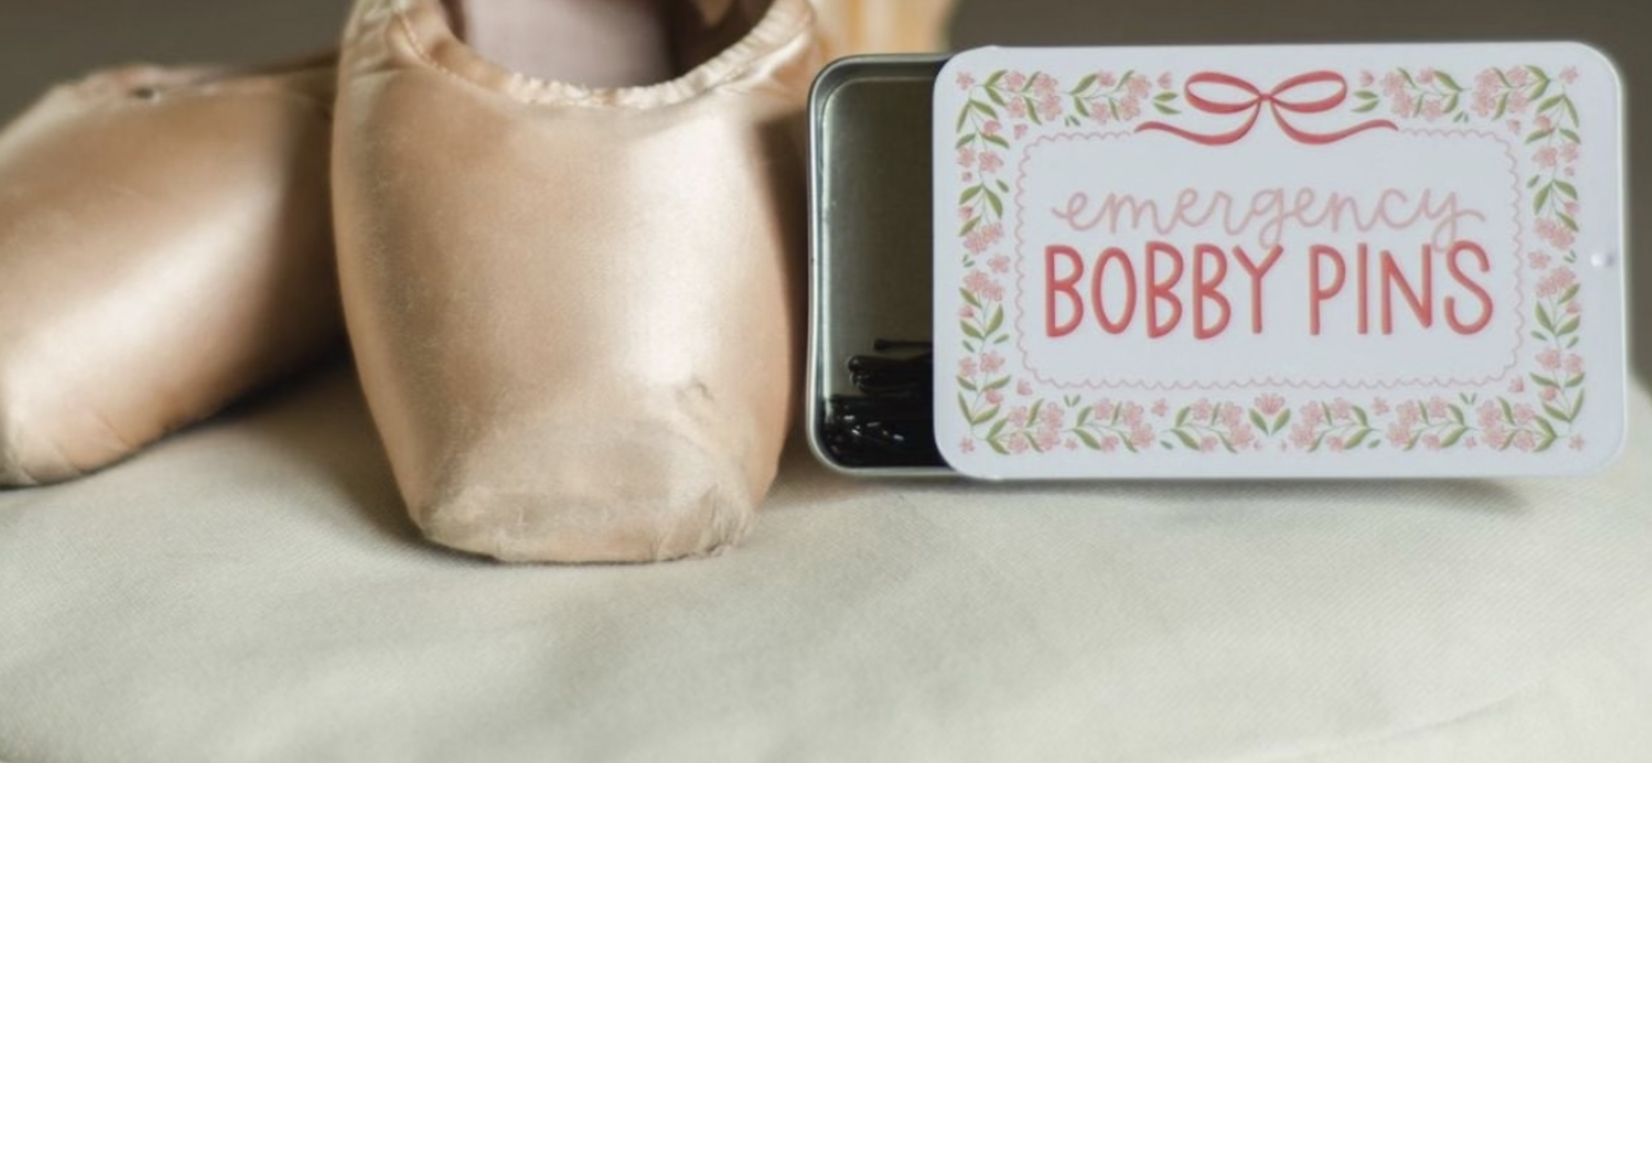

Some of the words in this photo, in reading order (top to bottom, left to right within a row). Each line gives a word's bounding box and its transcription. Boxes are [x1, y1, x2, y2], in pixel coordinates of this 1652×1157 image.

[1051, 187, 1487, 254] emergency
[1045, 241, 1284, 339] BOBBY
[1309, 240, 1494, 335] PINS
